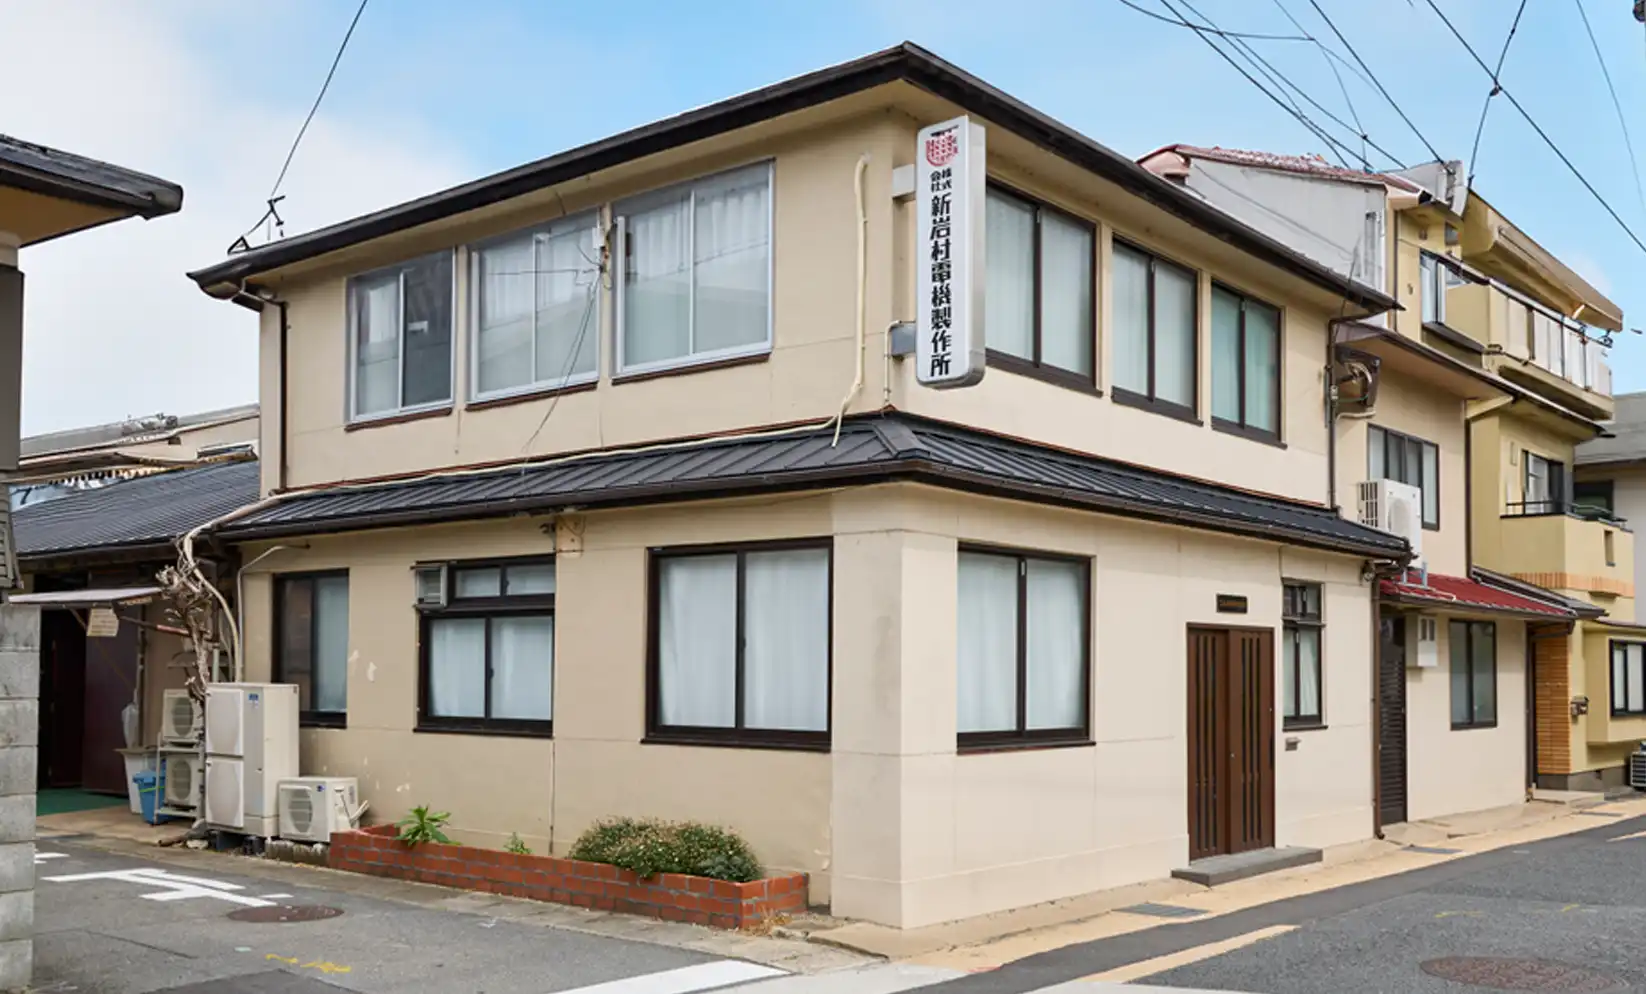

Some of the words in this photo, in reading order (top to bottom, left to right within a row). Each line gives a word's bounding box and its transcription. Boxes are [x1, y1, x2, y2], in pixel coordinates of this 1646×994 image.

[929, 192, 952, 377] 新岩村電機製作所
